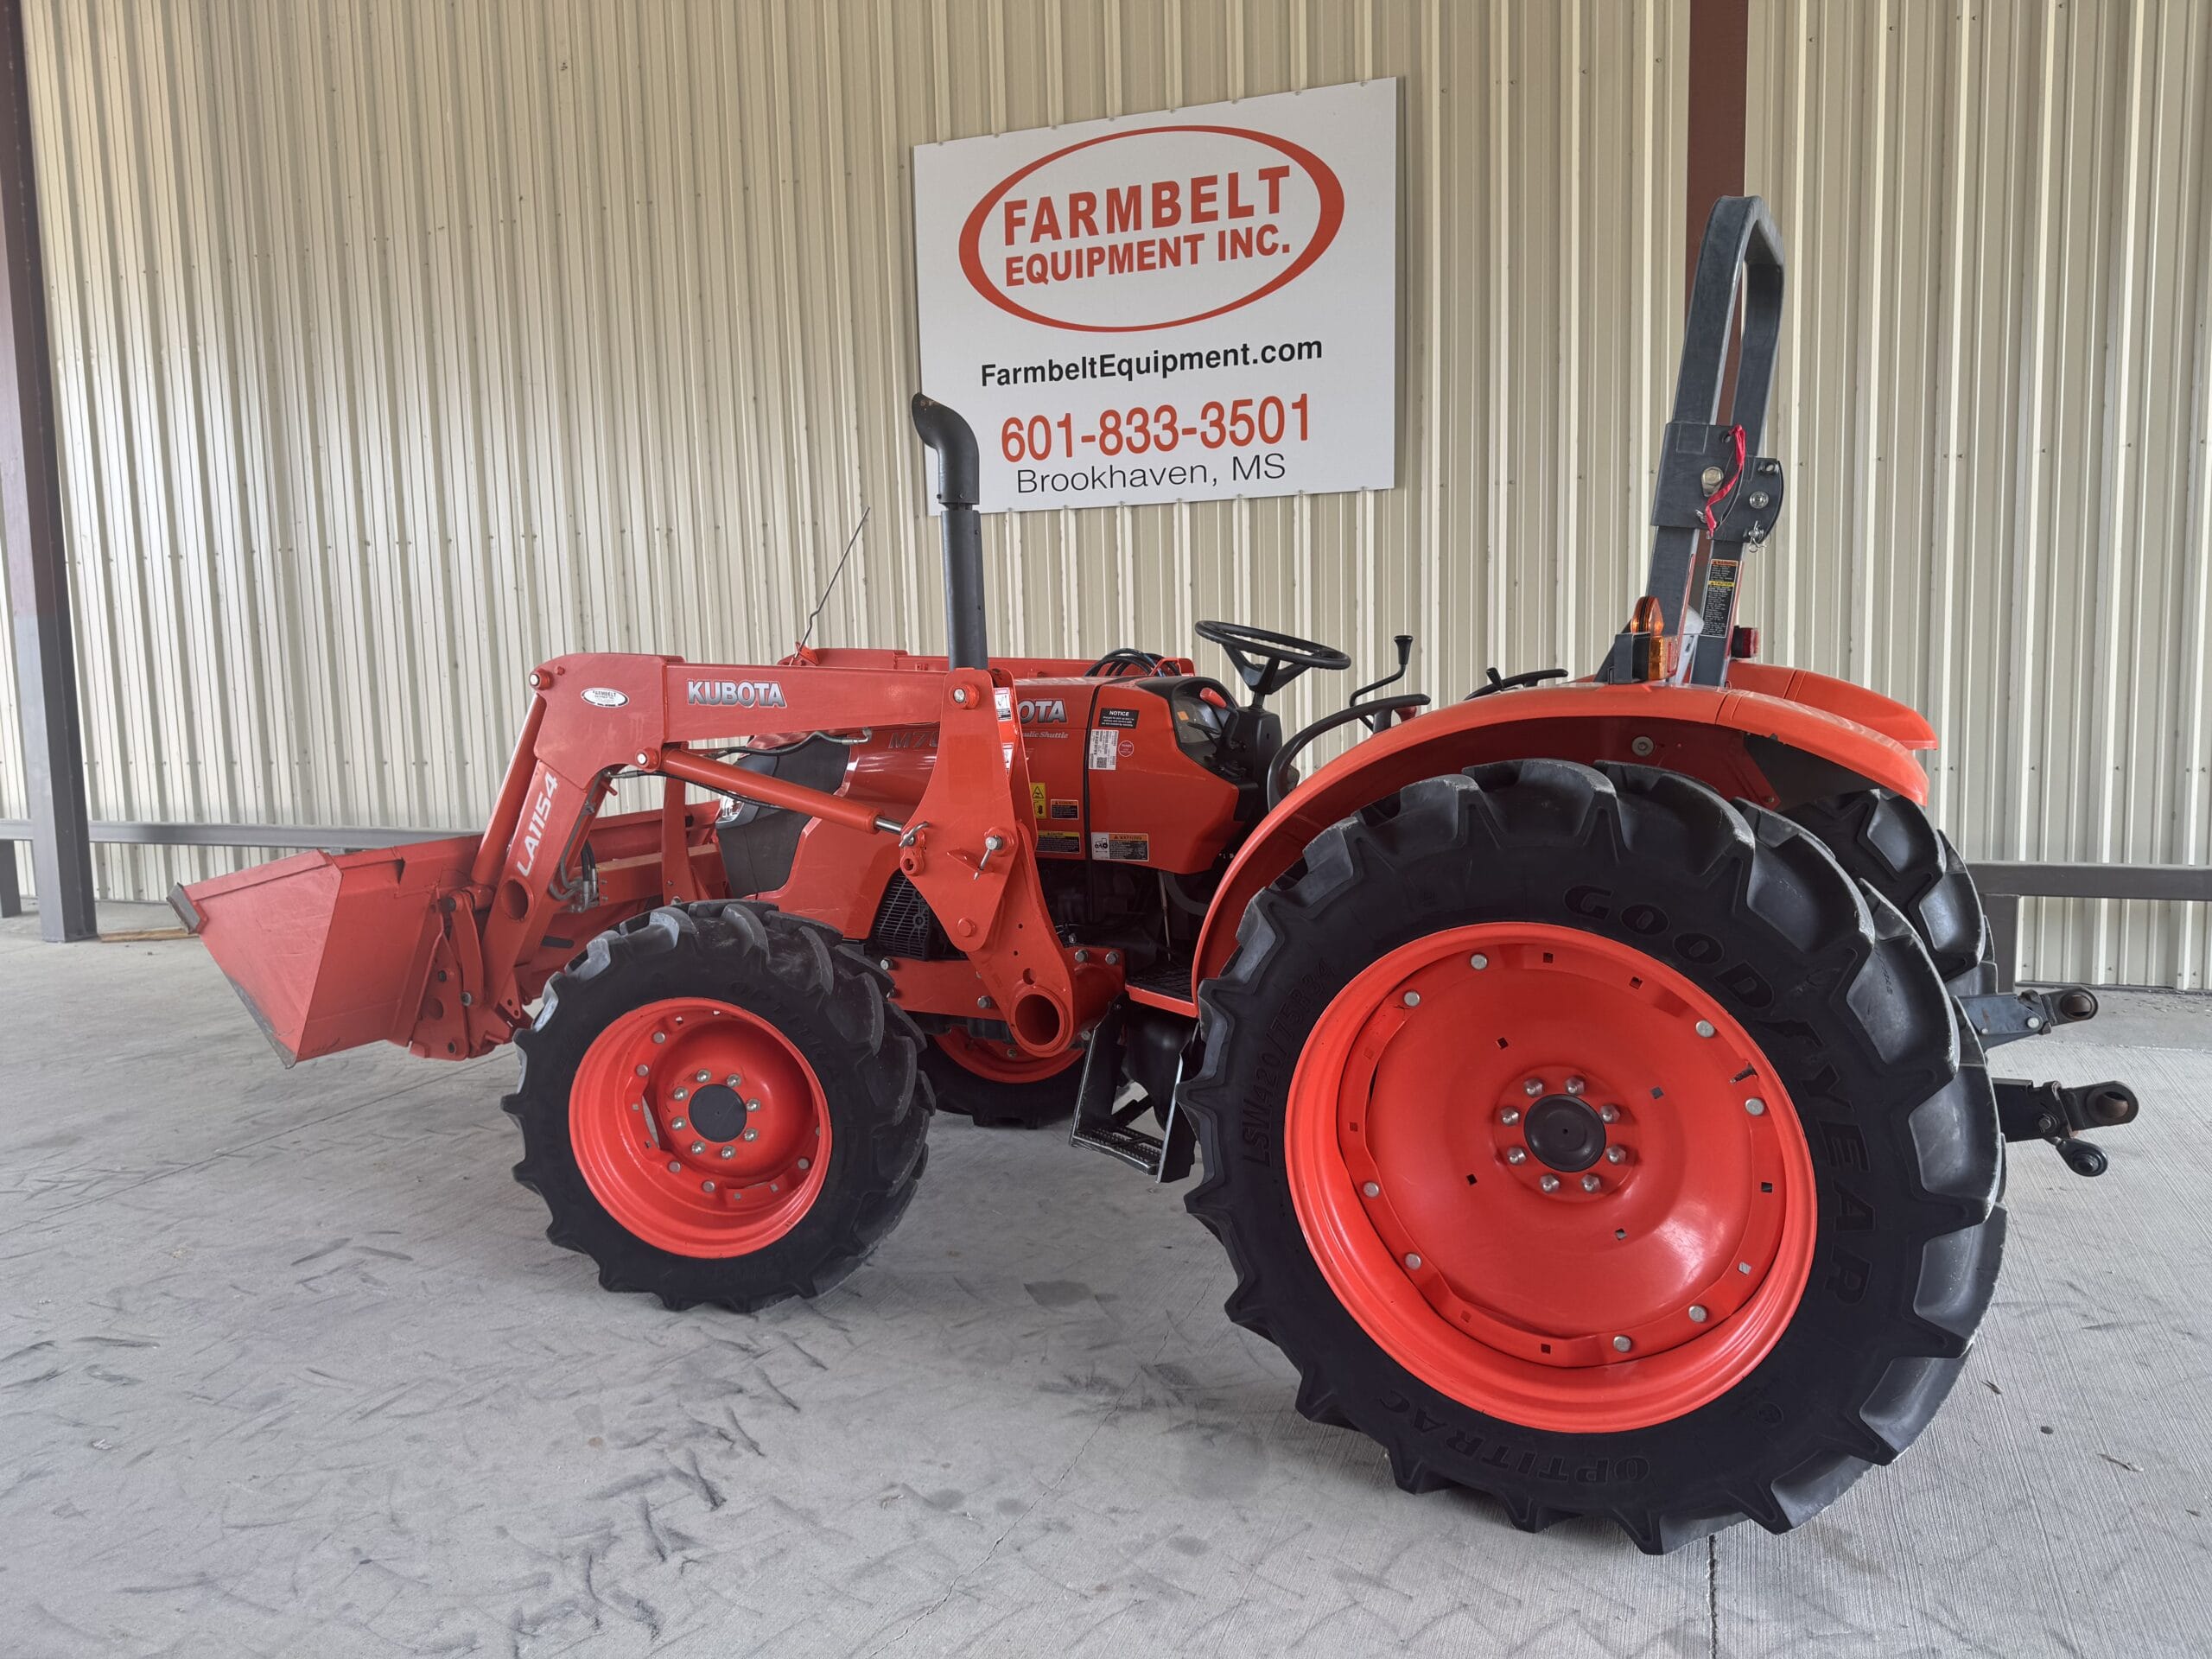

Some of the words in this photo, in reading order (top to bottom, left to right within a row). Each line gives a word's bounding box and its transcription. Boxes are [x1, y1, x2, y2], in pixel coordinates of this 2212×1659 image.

[1003, 165, 1290, 246] FARMBELT
[1005, 232, 1205, 287] EQUIPMENT
[1217, 224, 1291, 262] INC.
[981, 340, 1323, 387] FarmbeltEquipment.com
[1001, 393, 1309, 463] 601-833-3501
[1017, 462, 1217, 494] Brookhaven,
[1232, 452, 1287, 481] MS
[687, 679, 786, 708] KUBOTA
[1039, 730, 1069, 739] Shuttle
[517, 772, 558, 877] LA1154
[1377, 1388, 1651, 1484] OPTITRAC
